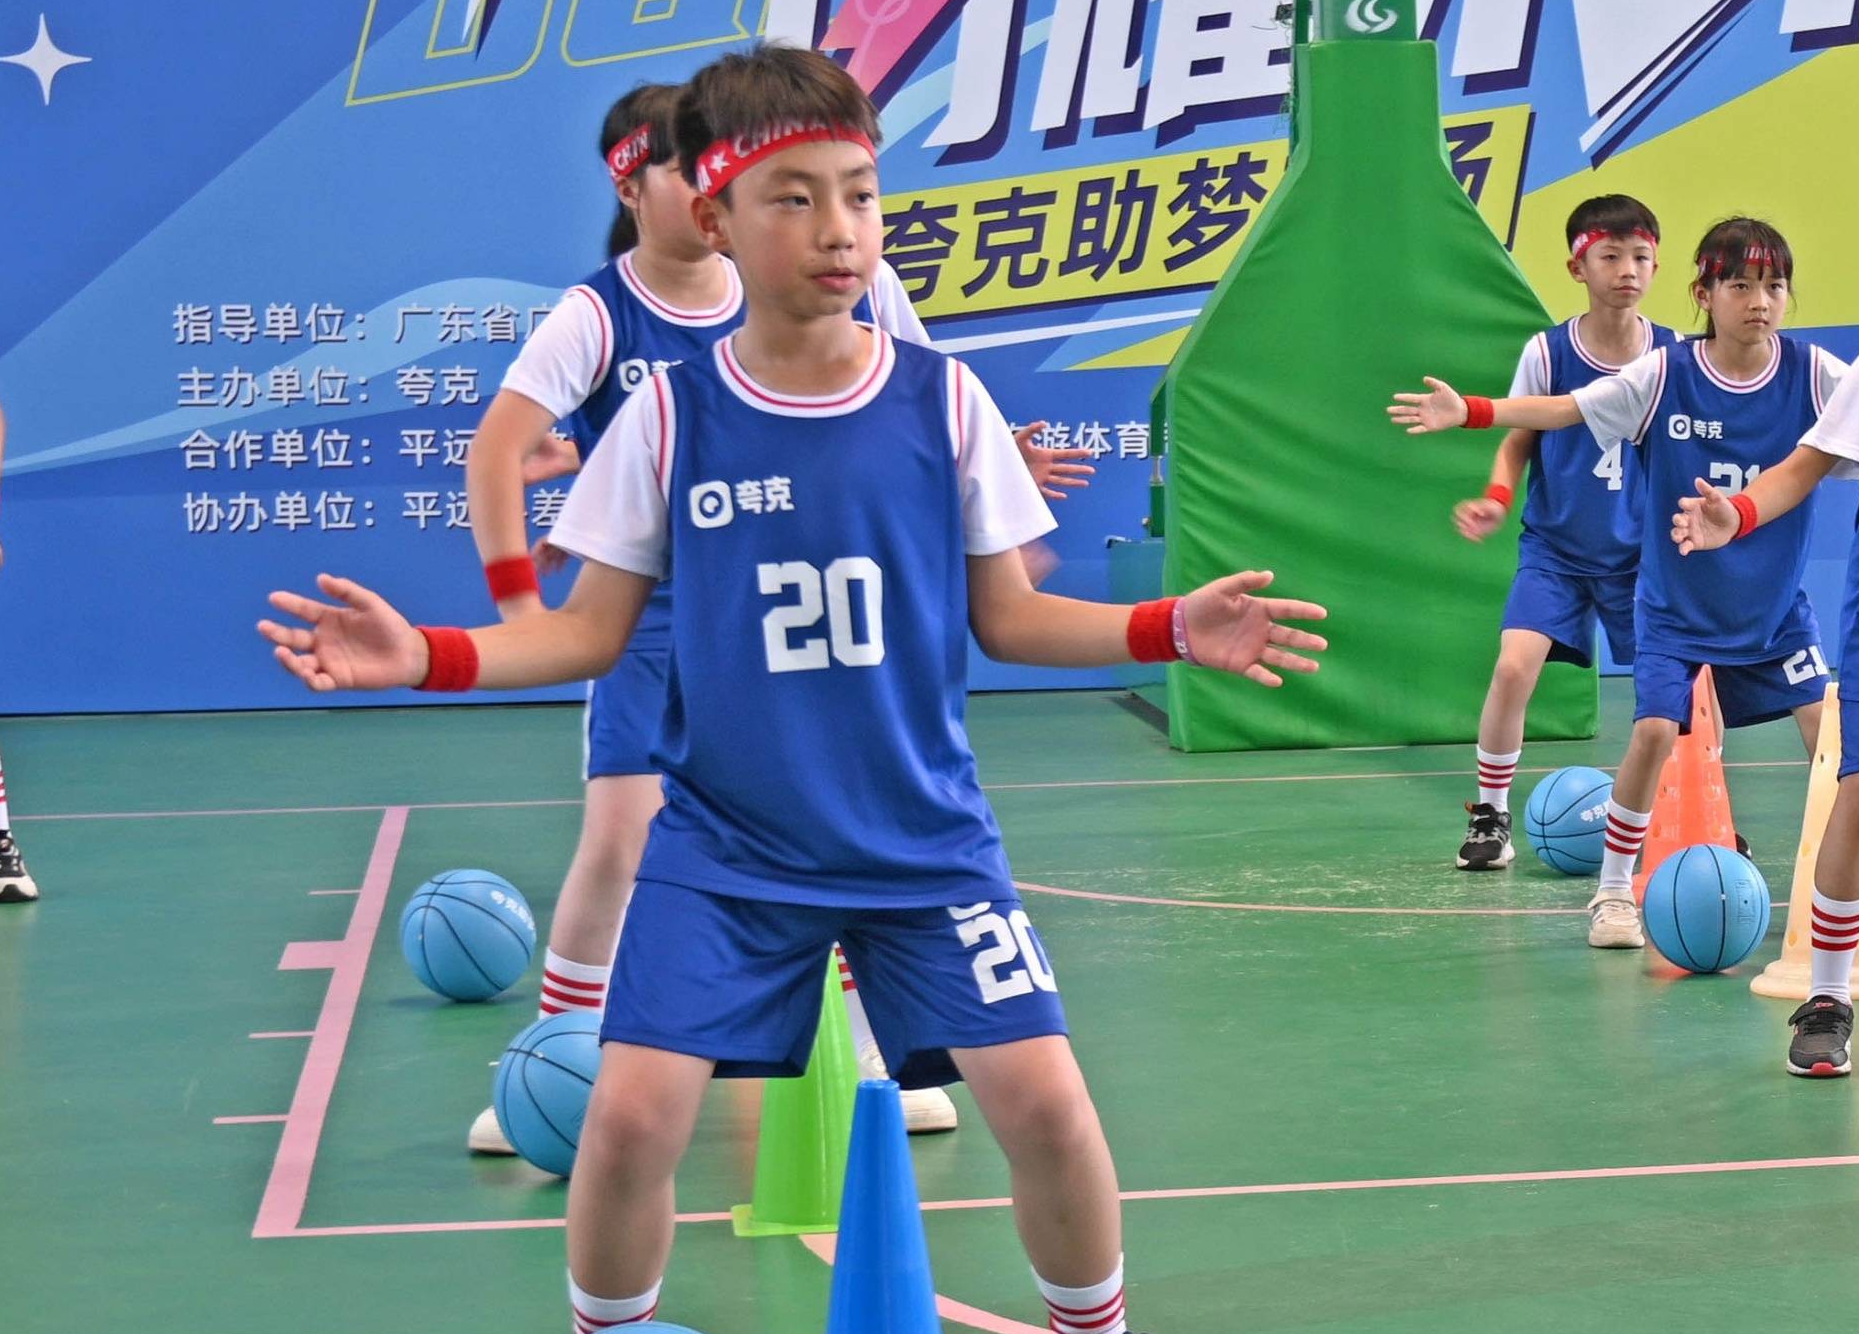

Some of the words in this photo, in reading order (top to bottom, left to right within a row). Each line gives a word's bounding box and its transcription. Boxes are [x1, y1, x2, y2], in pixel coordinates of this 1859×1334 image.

[177, 366, 480, 409] 主办单位：夸克
[1693, 419, 1723, 439] 夸克
[735, 476, 794, 515] 夸克
[757, 557, 885, 672] 20
[959, 905, 1063, 1006] 20
